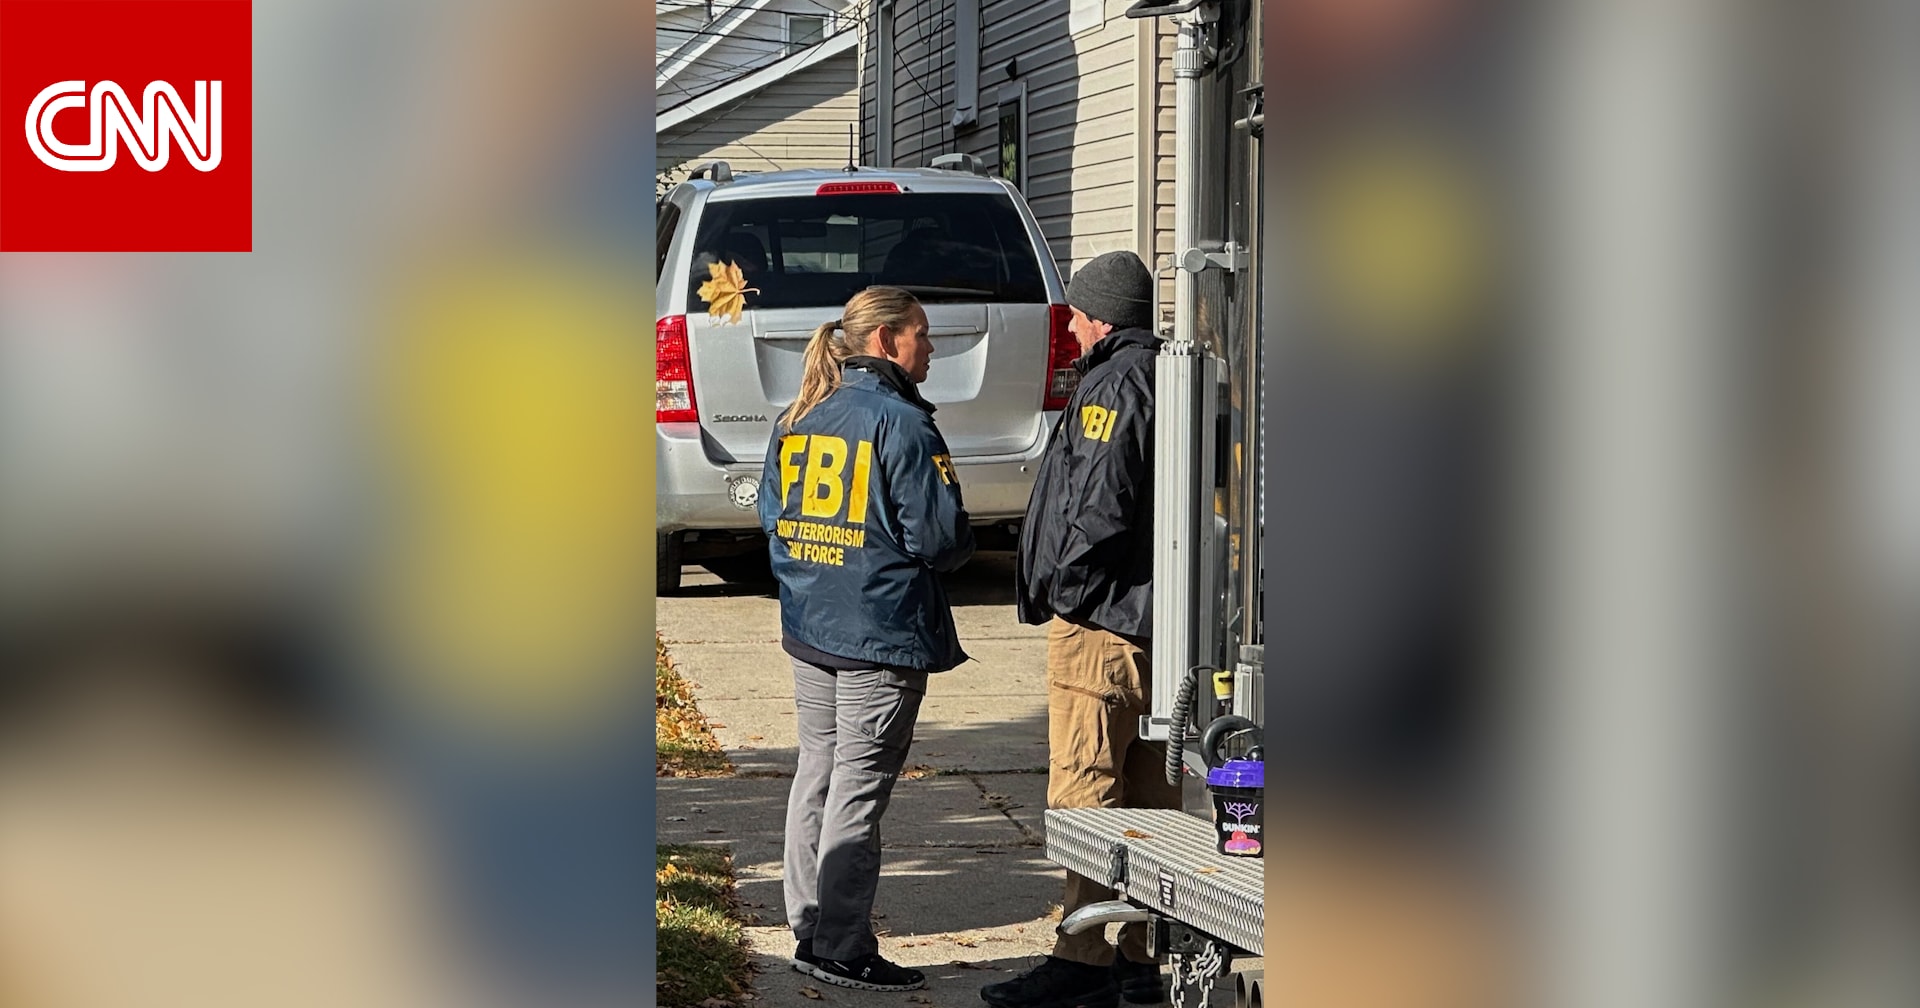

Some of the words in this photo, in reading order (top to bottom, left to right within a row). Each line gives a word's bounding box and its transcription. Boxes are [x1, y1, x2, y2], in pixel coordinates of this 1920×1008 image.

[779, 434, 872, 523] FBI
[798, 522, 865, 548] TERRORISM
[804, 543, 844, 566] FORCE
